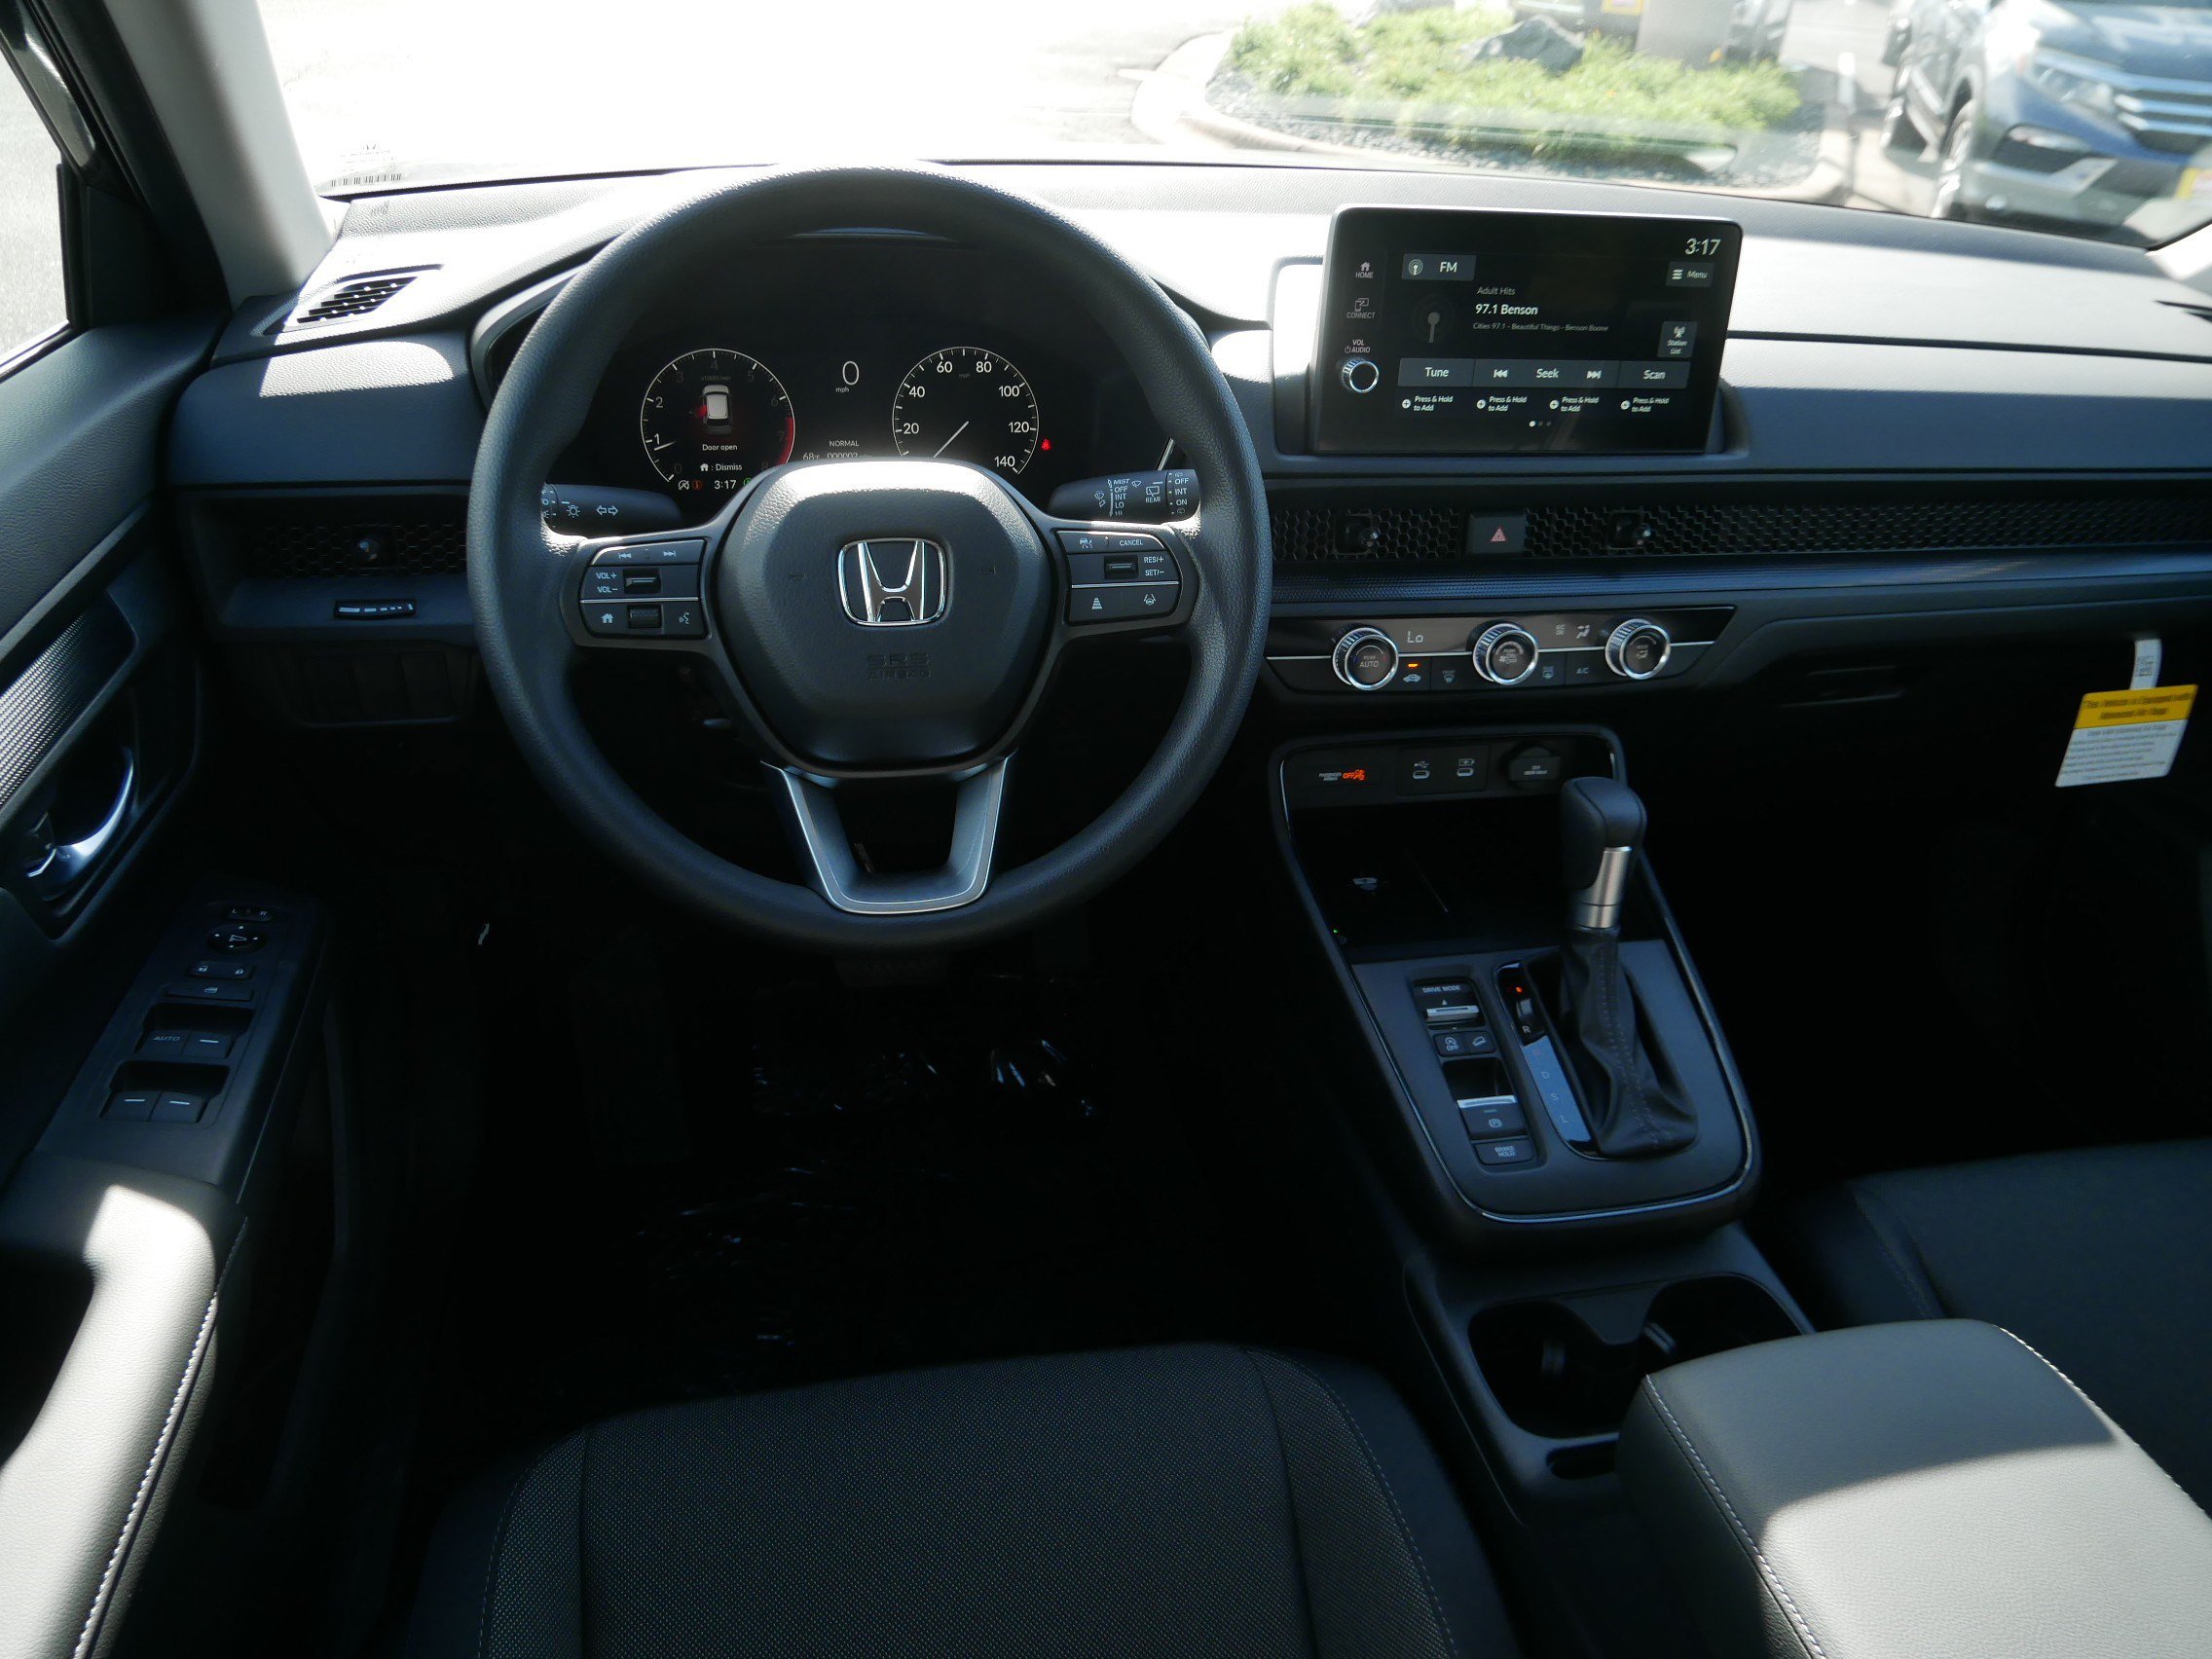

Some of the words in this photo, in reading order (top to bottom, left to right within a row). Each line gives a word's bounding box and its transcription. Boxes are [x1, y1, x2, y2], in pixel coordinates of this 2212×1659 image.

[1685, 238, 1721, 256] 3:17
[1439, 261, 1458, 273] FM
[1686, 271, 1708, 279] Menu
[1476, 286, 1498, 295] Adult
[1499, 287, 1516, 296] Hits
[1475, 304, 1497, 314] 97.1
[1500, 304, 1538, 315] Benson
[937, 361, 953, 373] 60
[976, 361, 992, 373] 80
[1424, 367, 1450, 378] Tune
[842, 360, 860, 386] 0
[1536, 368, 1560, 379] Seek
[1643, 370, 1666, 380] Scan
[908, 386, 926, 398] 40
[998, 386, 1019, 397] 100
[655, 396, 664, 408] 2
[903, 423, 919, 434] 20
[1009, 422, 1030, 433] 120
[653, 432, 660, 445] 1
[994, 455, 1015, 467] 140
[714, 479, 737, 490] 3:17
[1407, 630, 1424, 644] Lo
[1522, 1024, 1531, 1034] R
